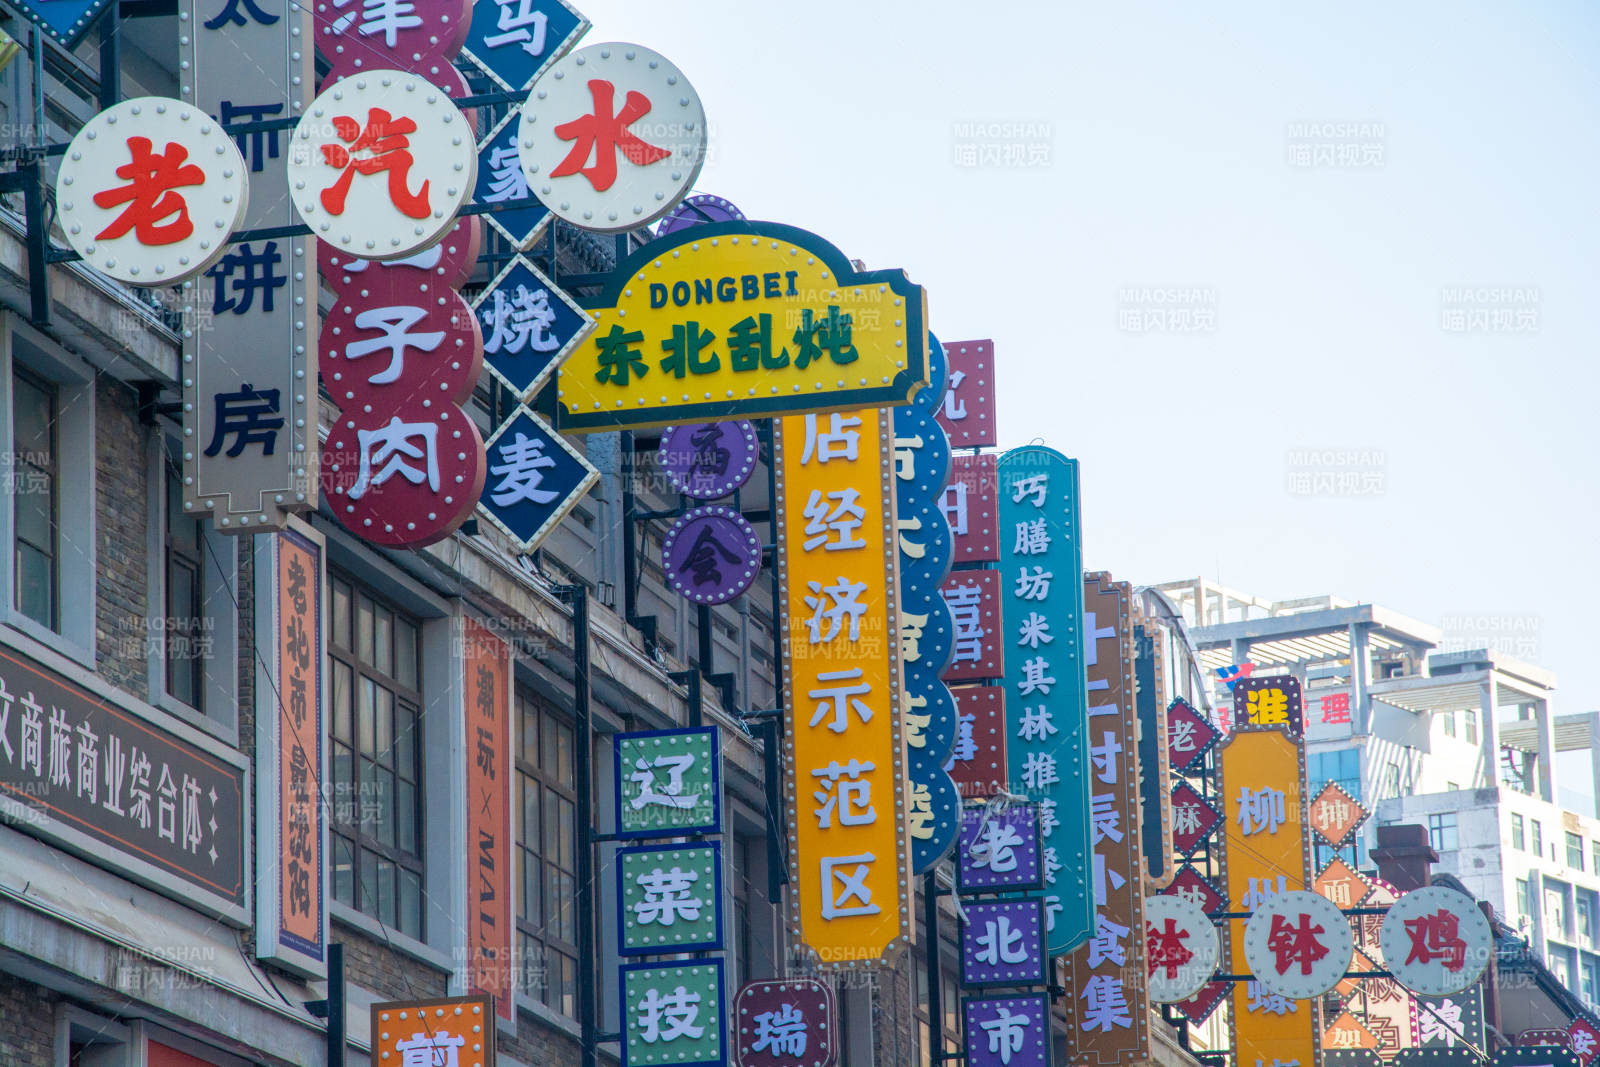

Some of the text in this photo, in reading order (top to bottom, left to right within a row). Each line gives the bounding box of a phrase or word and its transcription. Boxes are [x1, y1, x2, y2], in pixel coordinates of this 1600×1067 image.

[94, 80, 671, 246] 老汽水
[332, 0, 446, 500] 津子肉
[482, 0, 561, 508] 马家烧麦
[650, 270, 799, 308] DONGBEI
[595, 305, 859, 386] 东北乱炖
[800, 412, 881, 922] 店经济示范区
[629, 751, 705, 1044] 辽菜技
[970, 820, 1031, 1065] 老北市
[1168, 719, 1207, 1003] 老麻抄
[751, 1003, 808, 1058] 瑞
